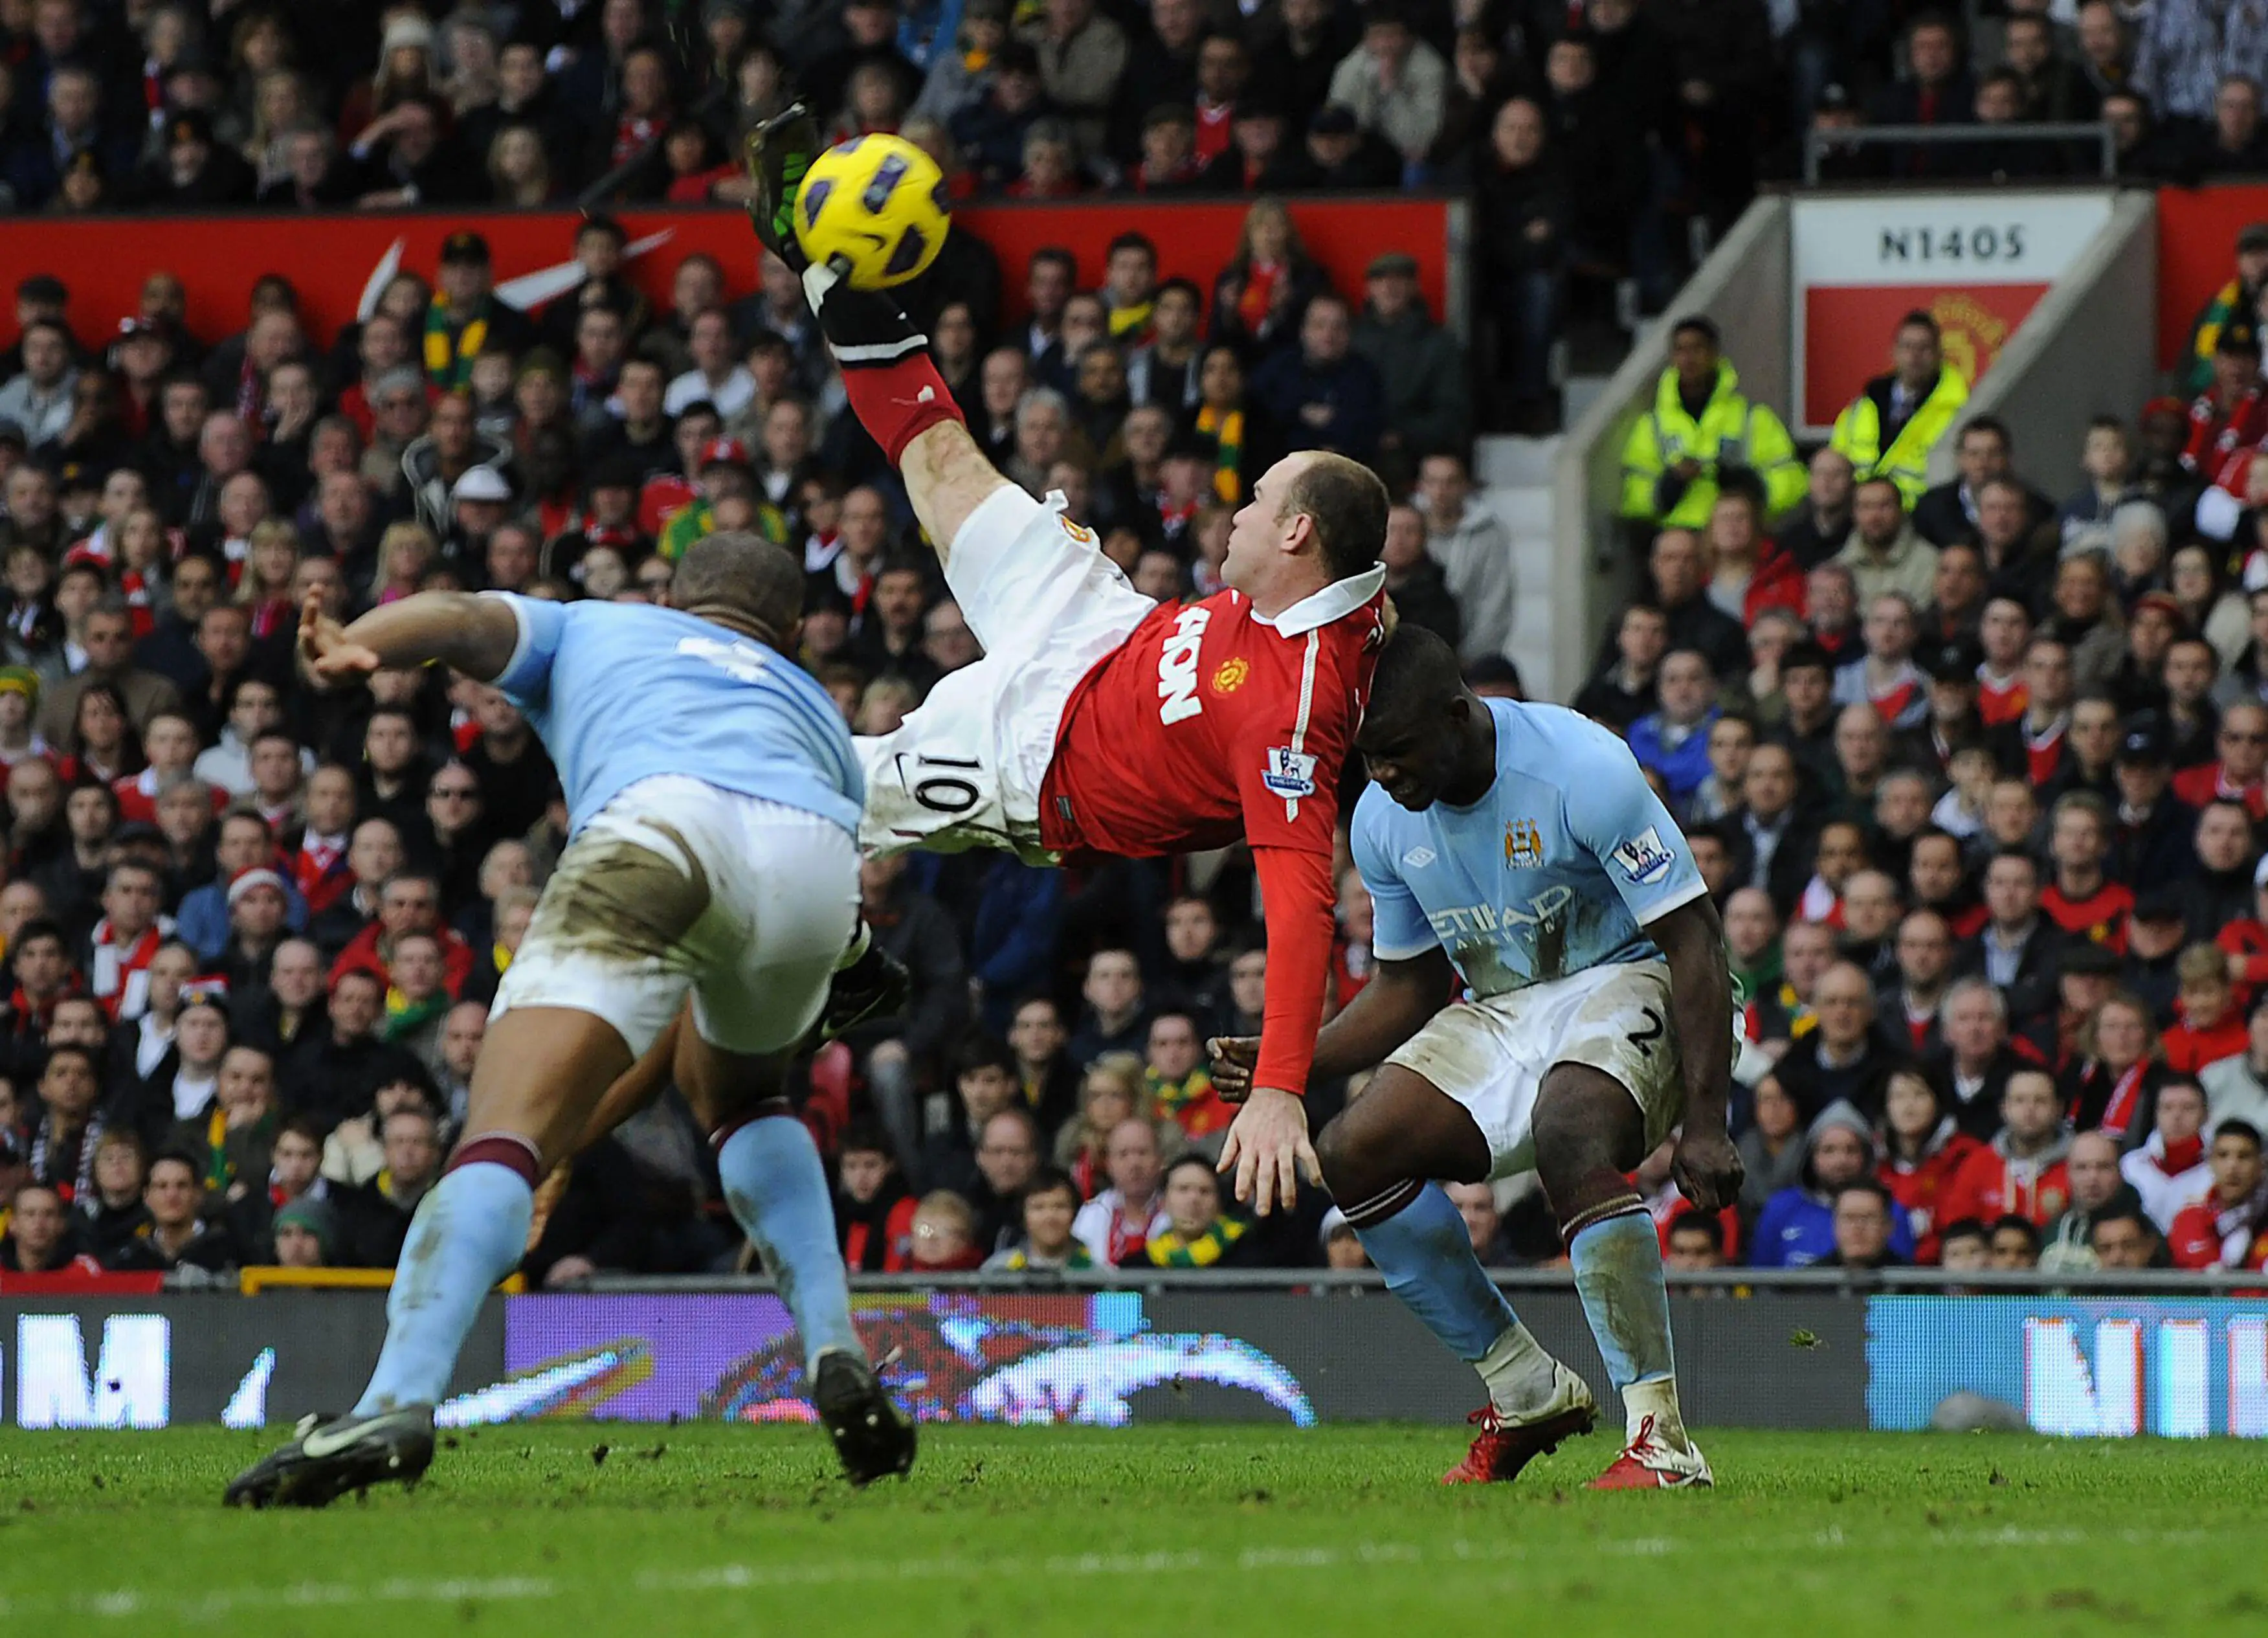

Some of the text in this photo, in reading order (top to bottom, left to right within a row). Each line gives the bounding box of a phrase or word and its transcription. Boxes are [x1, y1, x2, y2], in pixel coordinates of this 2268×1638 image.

[1879, 225, 2027, 262] N1405
[915, 753, 981, 813] 10
[1627, 1007, 1663, 1057] 2
[0, 1313, 171, 1430] M
